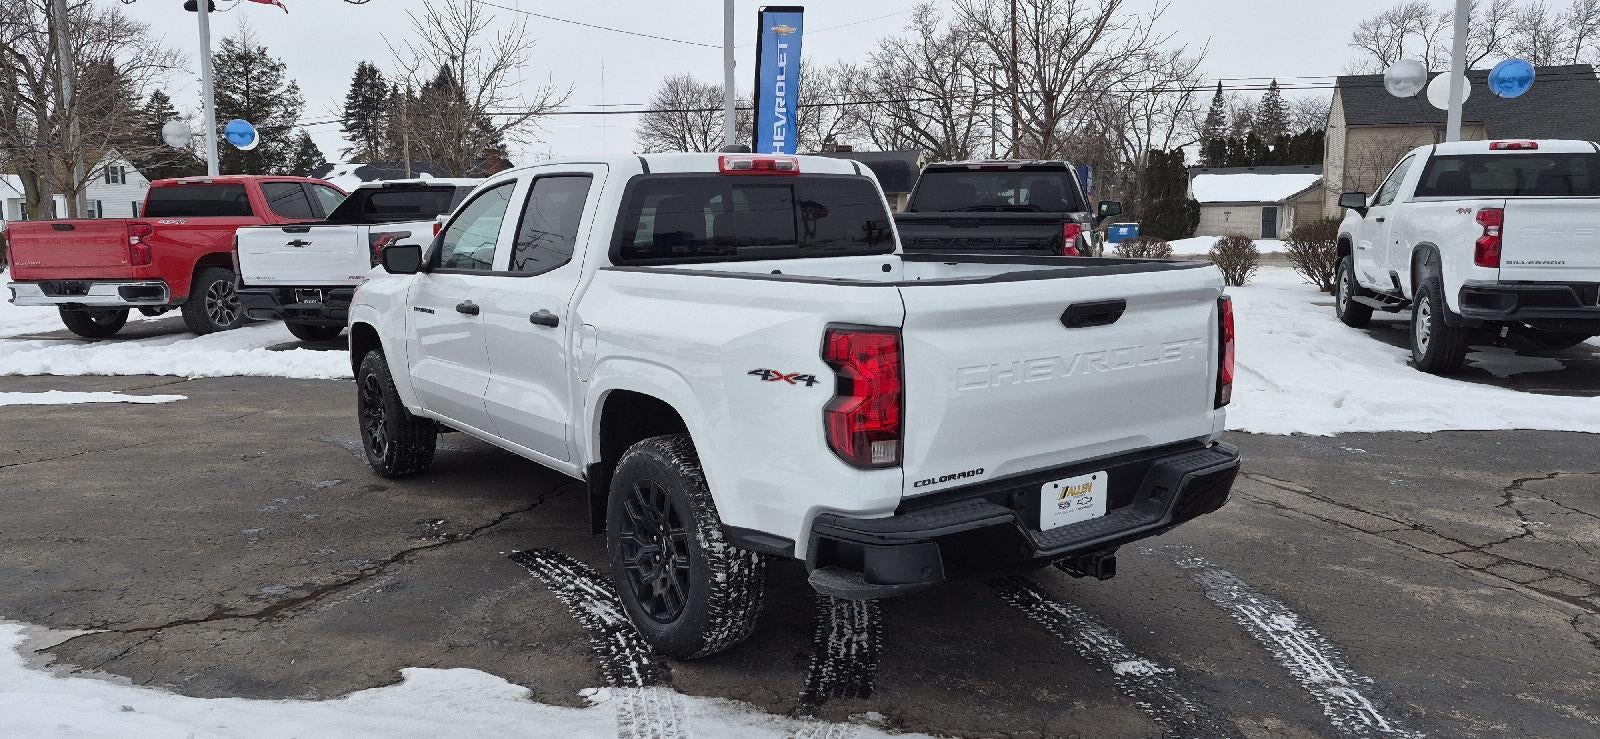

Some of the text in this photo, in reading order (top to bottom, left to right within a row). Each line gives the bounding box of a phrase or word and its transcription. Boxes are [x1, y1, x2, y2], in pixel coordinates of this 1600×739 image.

[772, 39, 788, 154] HEVROLET
[957, 338, 1203, 392] CHEVROLET
[913, 467, 985, 488] COLORADO
[1067, 482, 1093, 497] ALLEN
